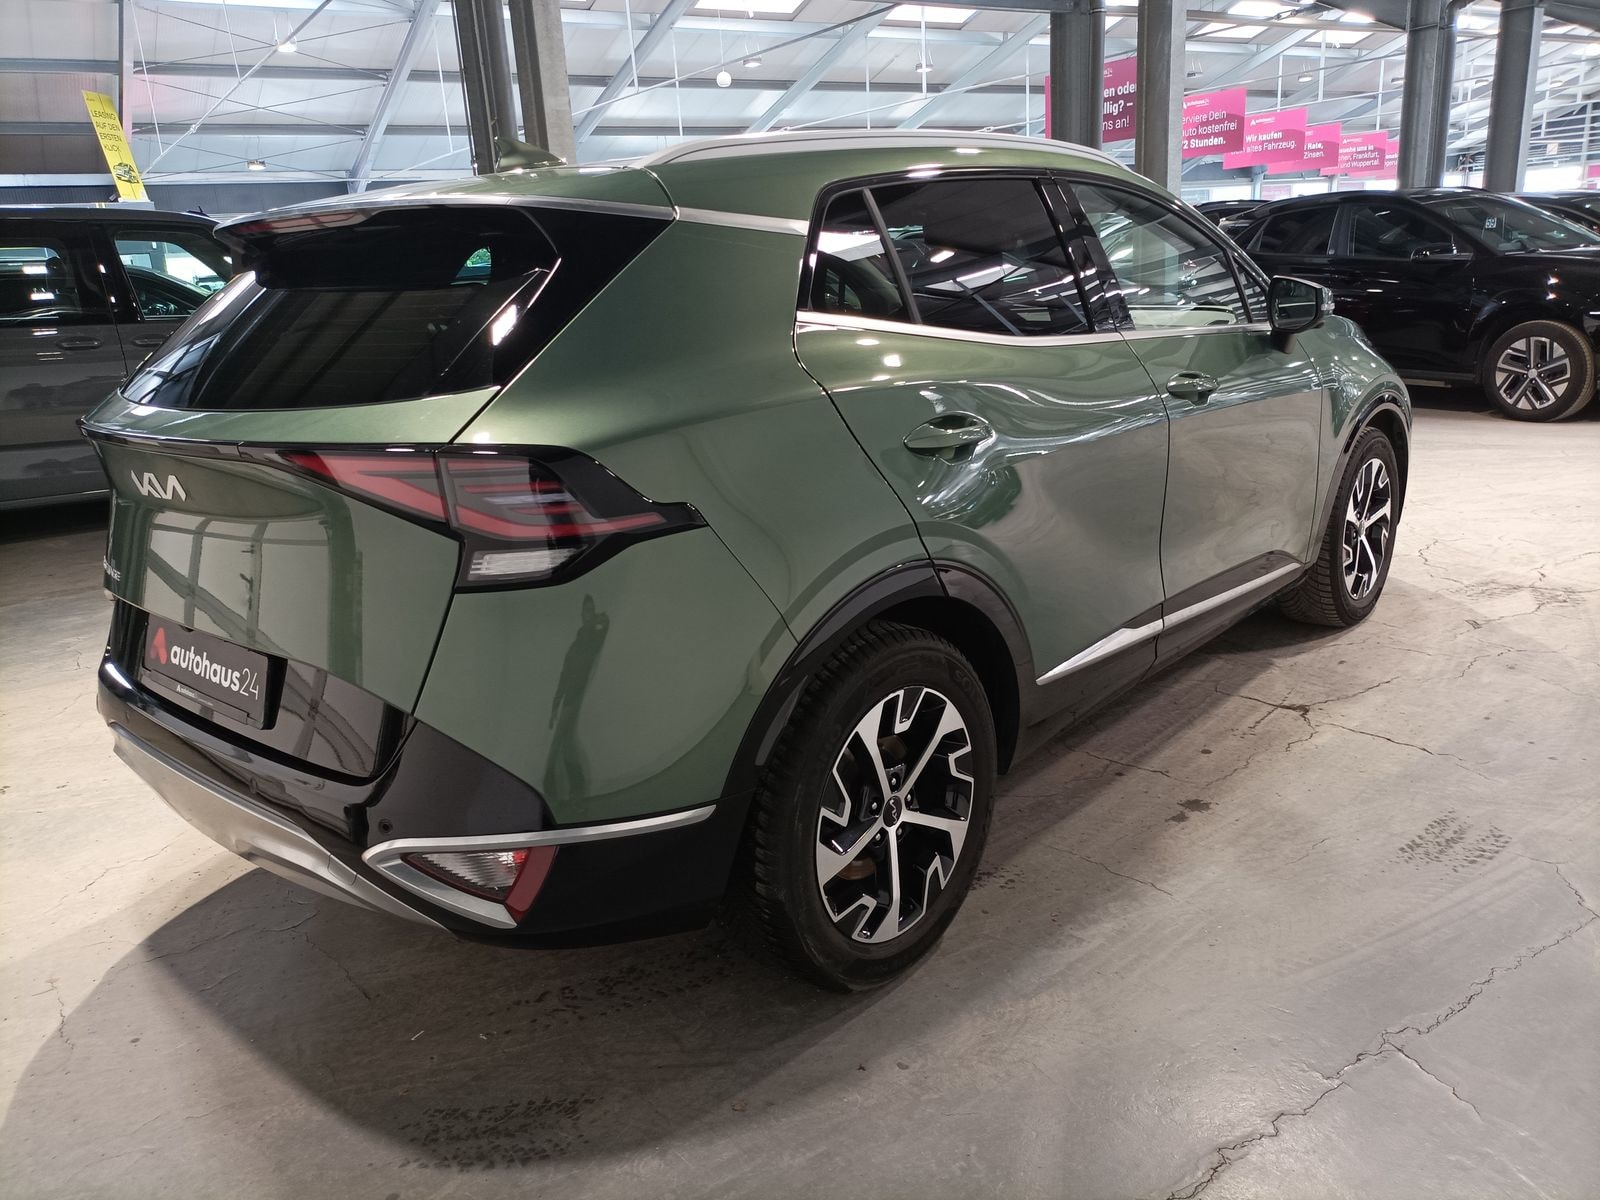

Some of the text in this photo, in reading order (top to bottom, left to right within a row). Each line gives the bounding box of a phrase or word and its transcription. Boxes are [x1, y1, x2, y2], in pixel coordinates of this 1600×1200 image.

[1209, 109, 1227, 121] Dein
[1115, 115, 1130, 129] an!
[1198, 119, 1238, 135] kostenfrei
[1190, 136, 1226, 149] Stunden.
[1245, 131, 1283, 143] Wir kaufen
[1246, 143, 1263, 153] altes
[1263, 140, 1297, 151] Fahrzeug.
[170, 645, 259, 700] autohaus24
